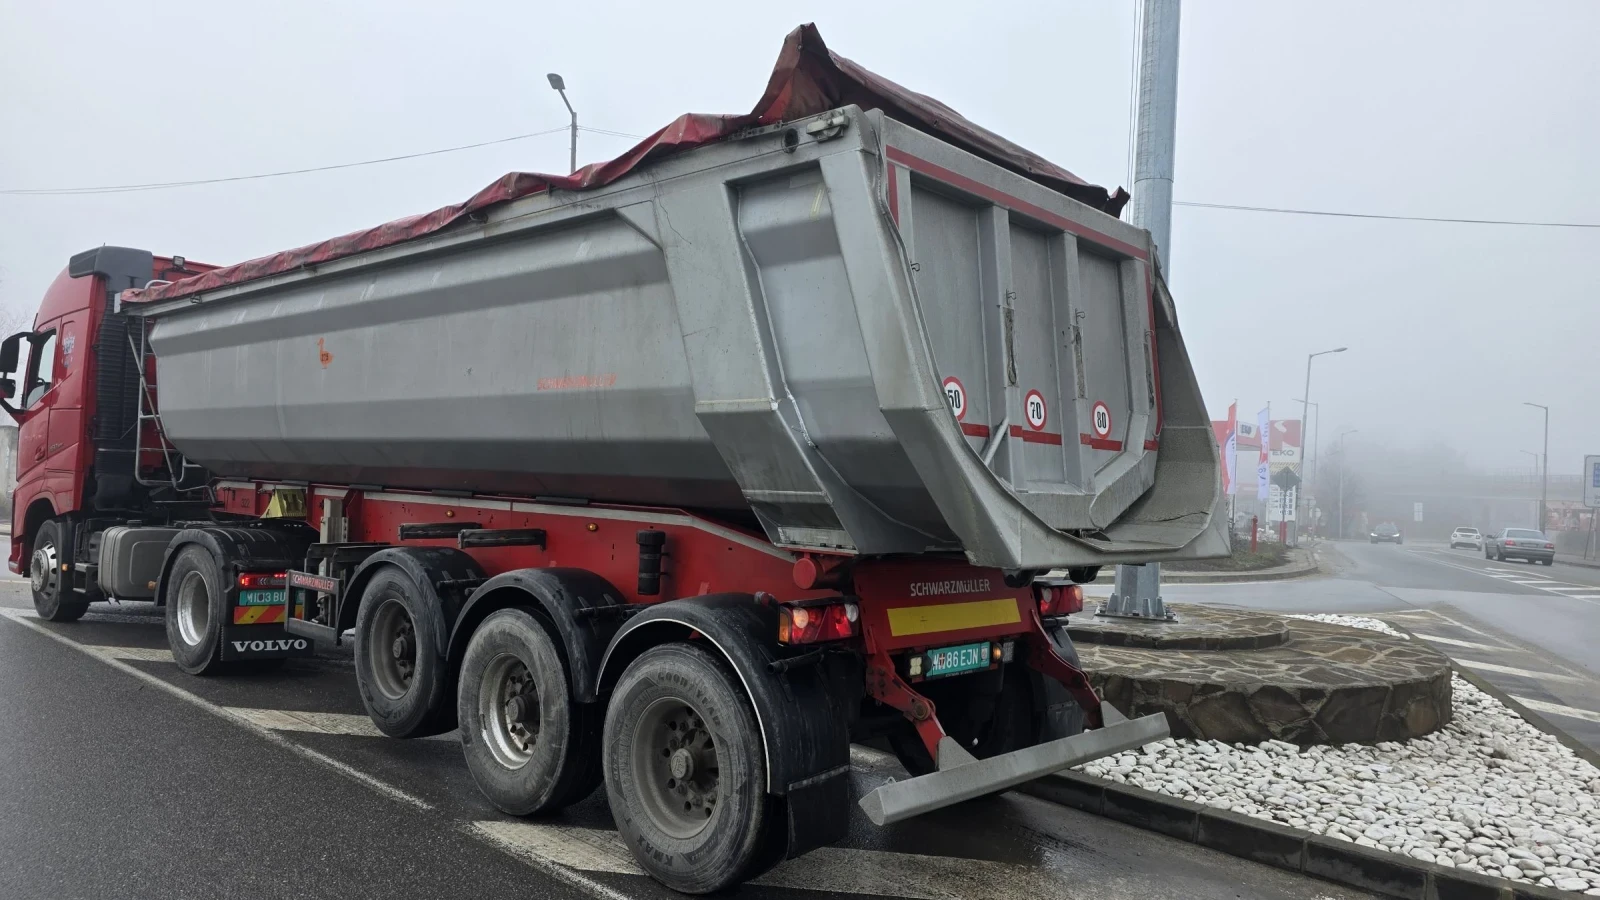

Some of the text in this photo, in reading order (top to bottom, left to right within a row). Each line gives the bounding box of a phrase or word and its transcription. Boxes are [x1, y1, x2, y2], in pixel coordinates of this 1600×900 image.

[1030, 401, 1042, 420] 70
[1096, 411, 1107, 429] 80
[273, 591, 287, 602] BU
[910, 579, 991, 597] SCHWARZMÜLLER
[231, 639, 308, 653] VOLVO
[946, 651, 959, 668] 86
[960, 648, 979, 667] EJN
